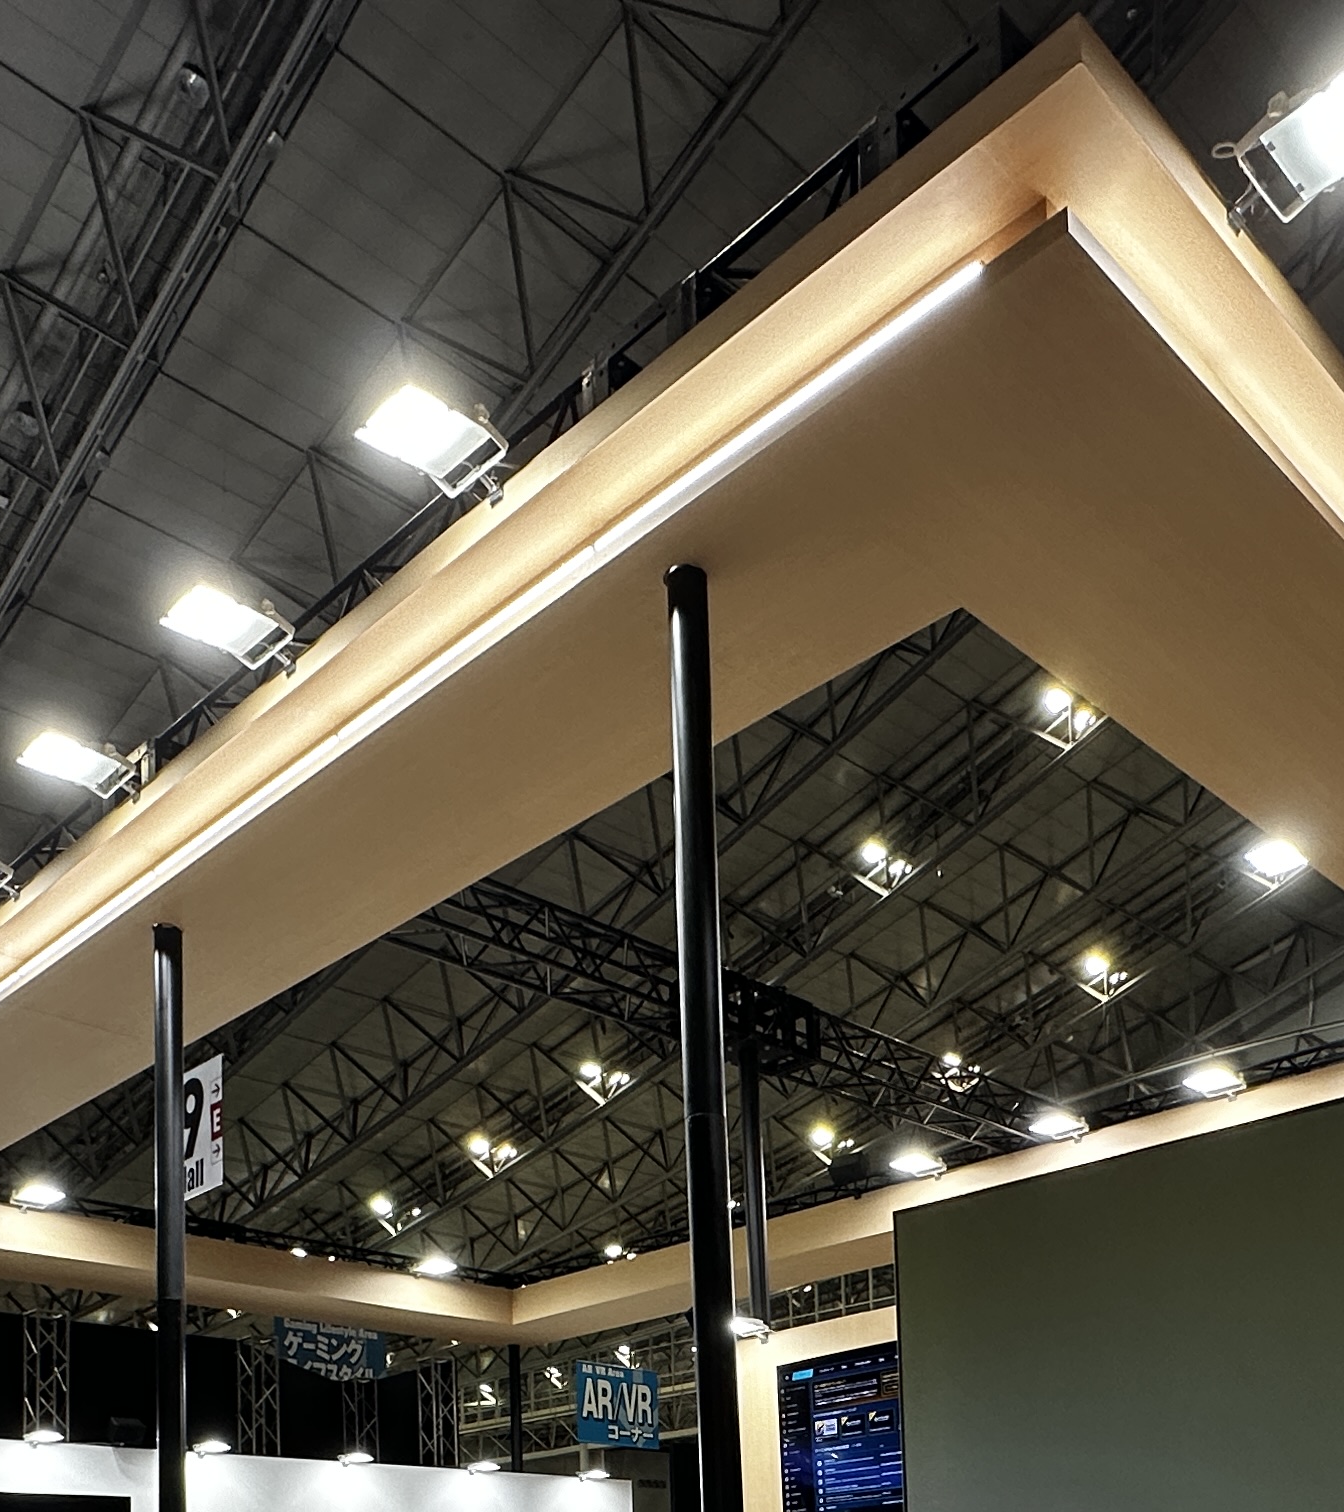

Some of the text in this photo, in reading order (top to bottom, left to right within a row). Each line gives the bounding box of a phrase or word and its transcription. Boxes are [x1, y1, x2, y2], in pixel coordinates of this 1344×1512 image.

[184, 1077, 204, 1162] 9
[213, 1108, 221, 1133] E
[184, 1158, 204, 1193] all
[284, 1330, 364, 1364] ゲーミング
[358, 1328, 378, 1340] Area
[595, 1366, 606, 1375] VR
[608, 1368, 624, 1378] Area
[582, 1377, 653, 1424] AR/VR
[608, 1425, 654, 1442] コーナー
